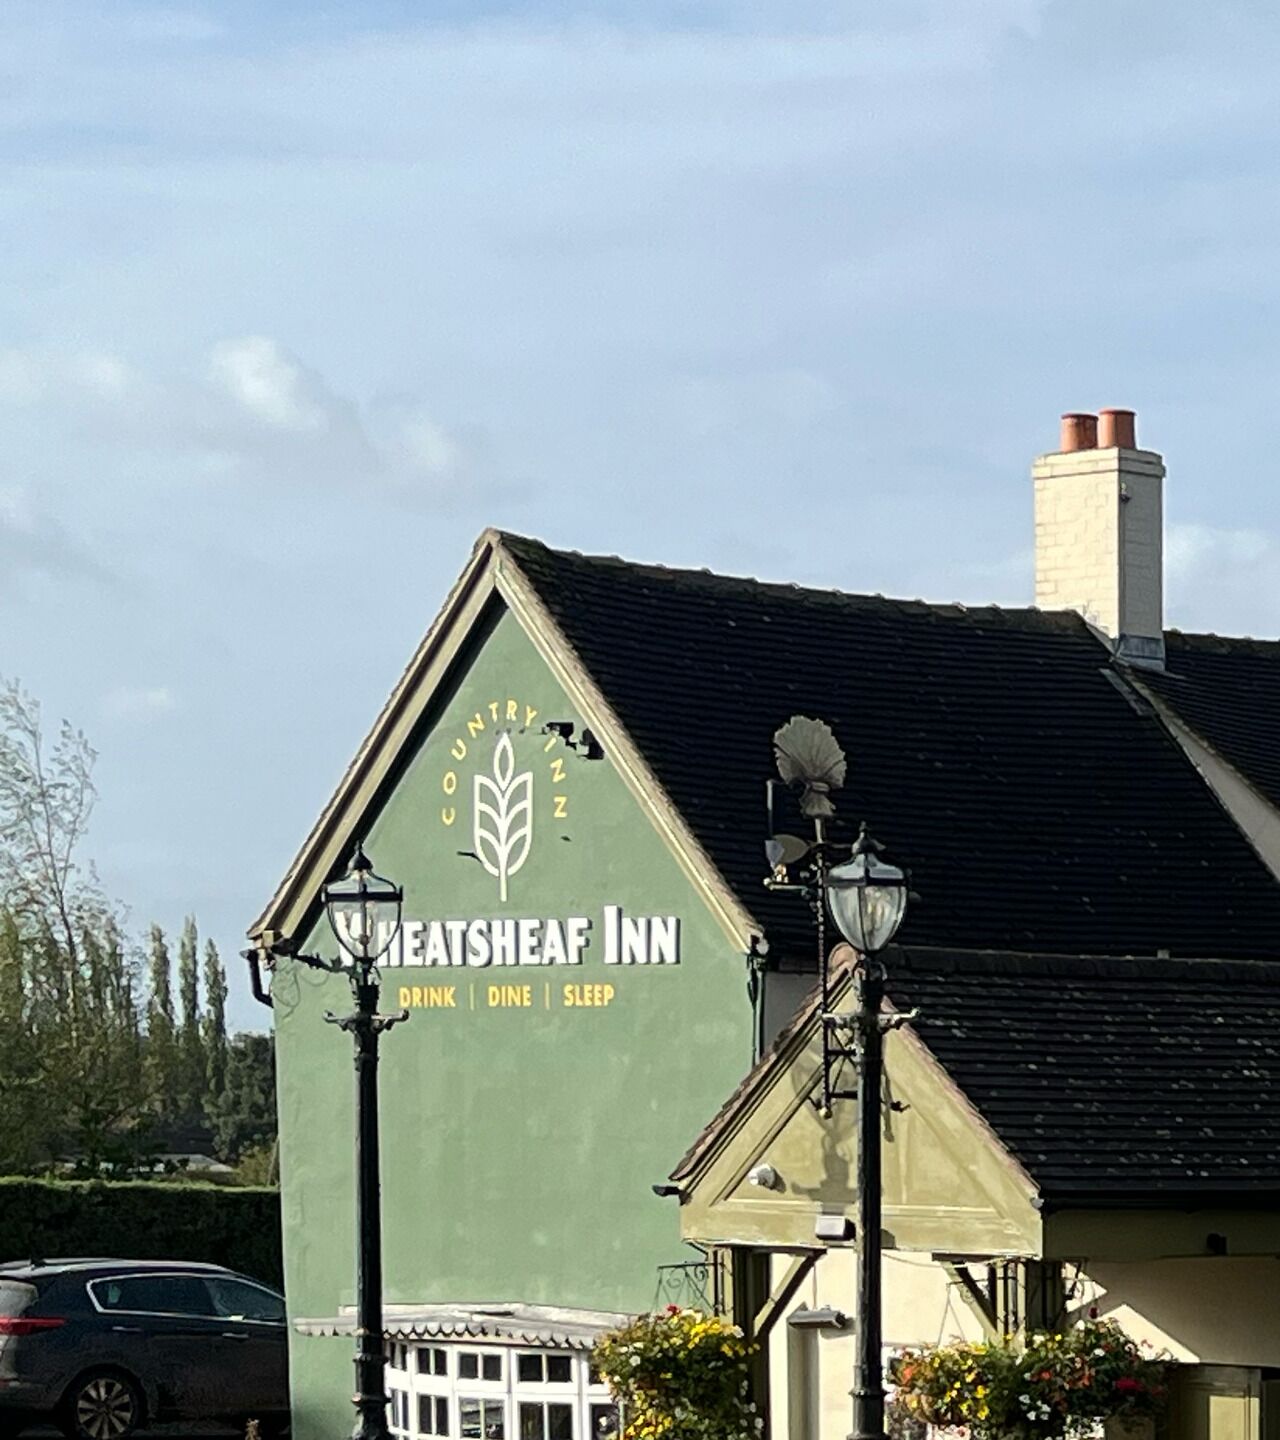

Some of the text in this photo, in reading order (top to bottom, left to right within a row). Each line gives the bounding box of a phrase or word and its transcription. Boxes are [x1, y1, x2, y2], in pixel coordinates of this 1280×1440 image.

[442, 700, 568, 825] COUNTRY INN
[334, 905, 679, 967] WHEATSHEAF INN
[399, 983, 615, 1008] DRINK DINE SLEEP
